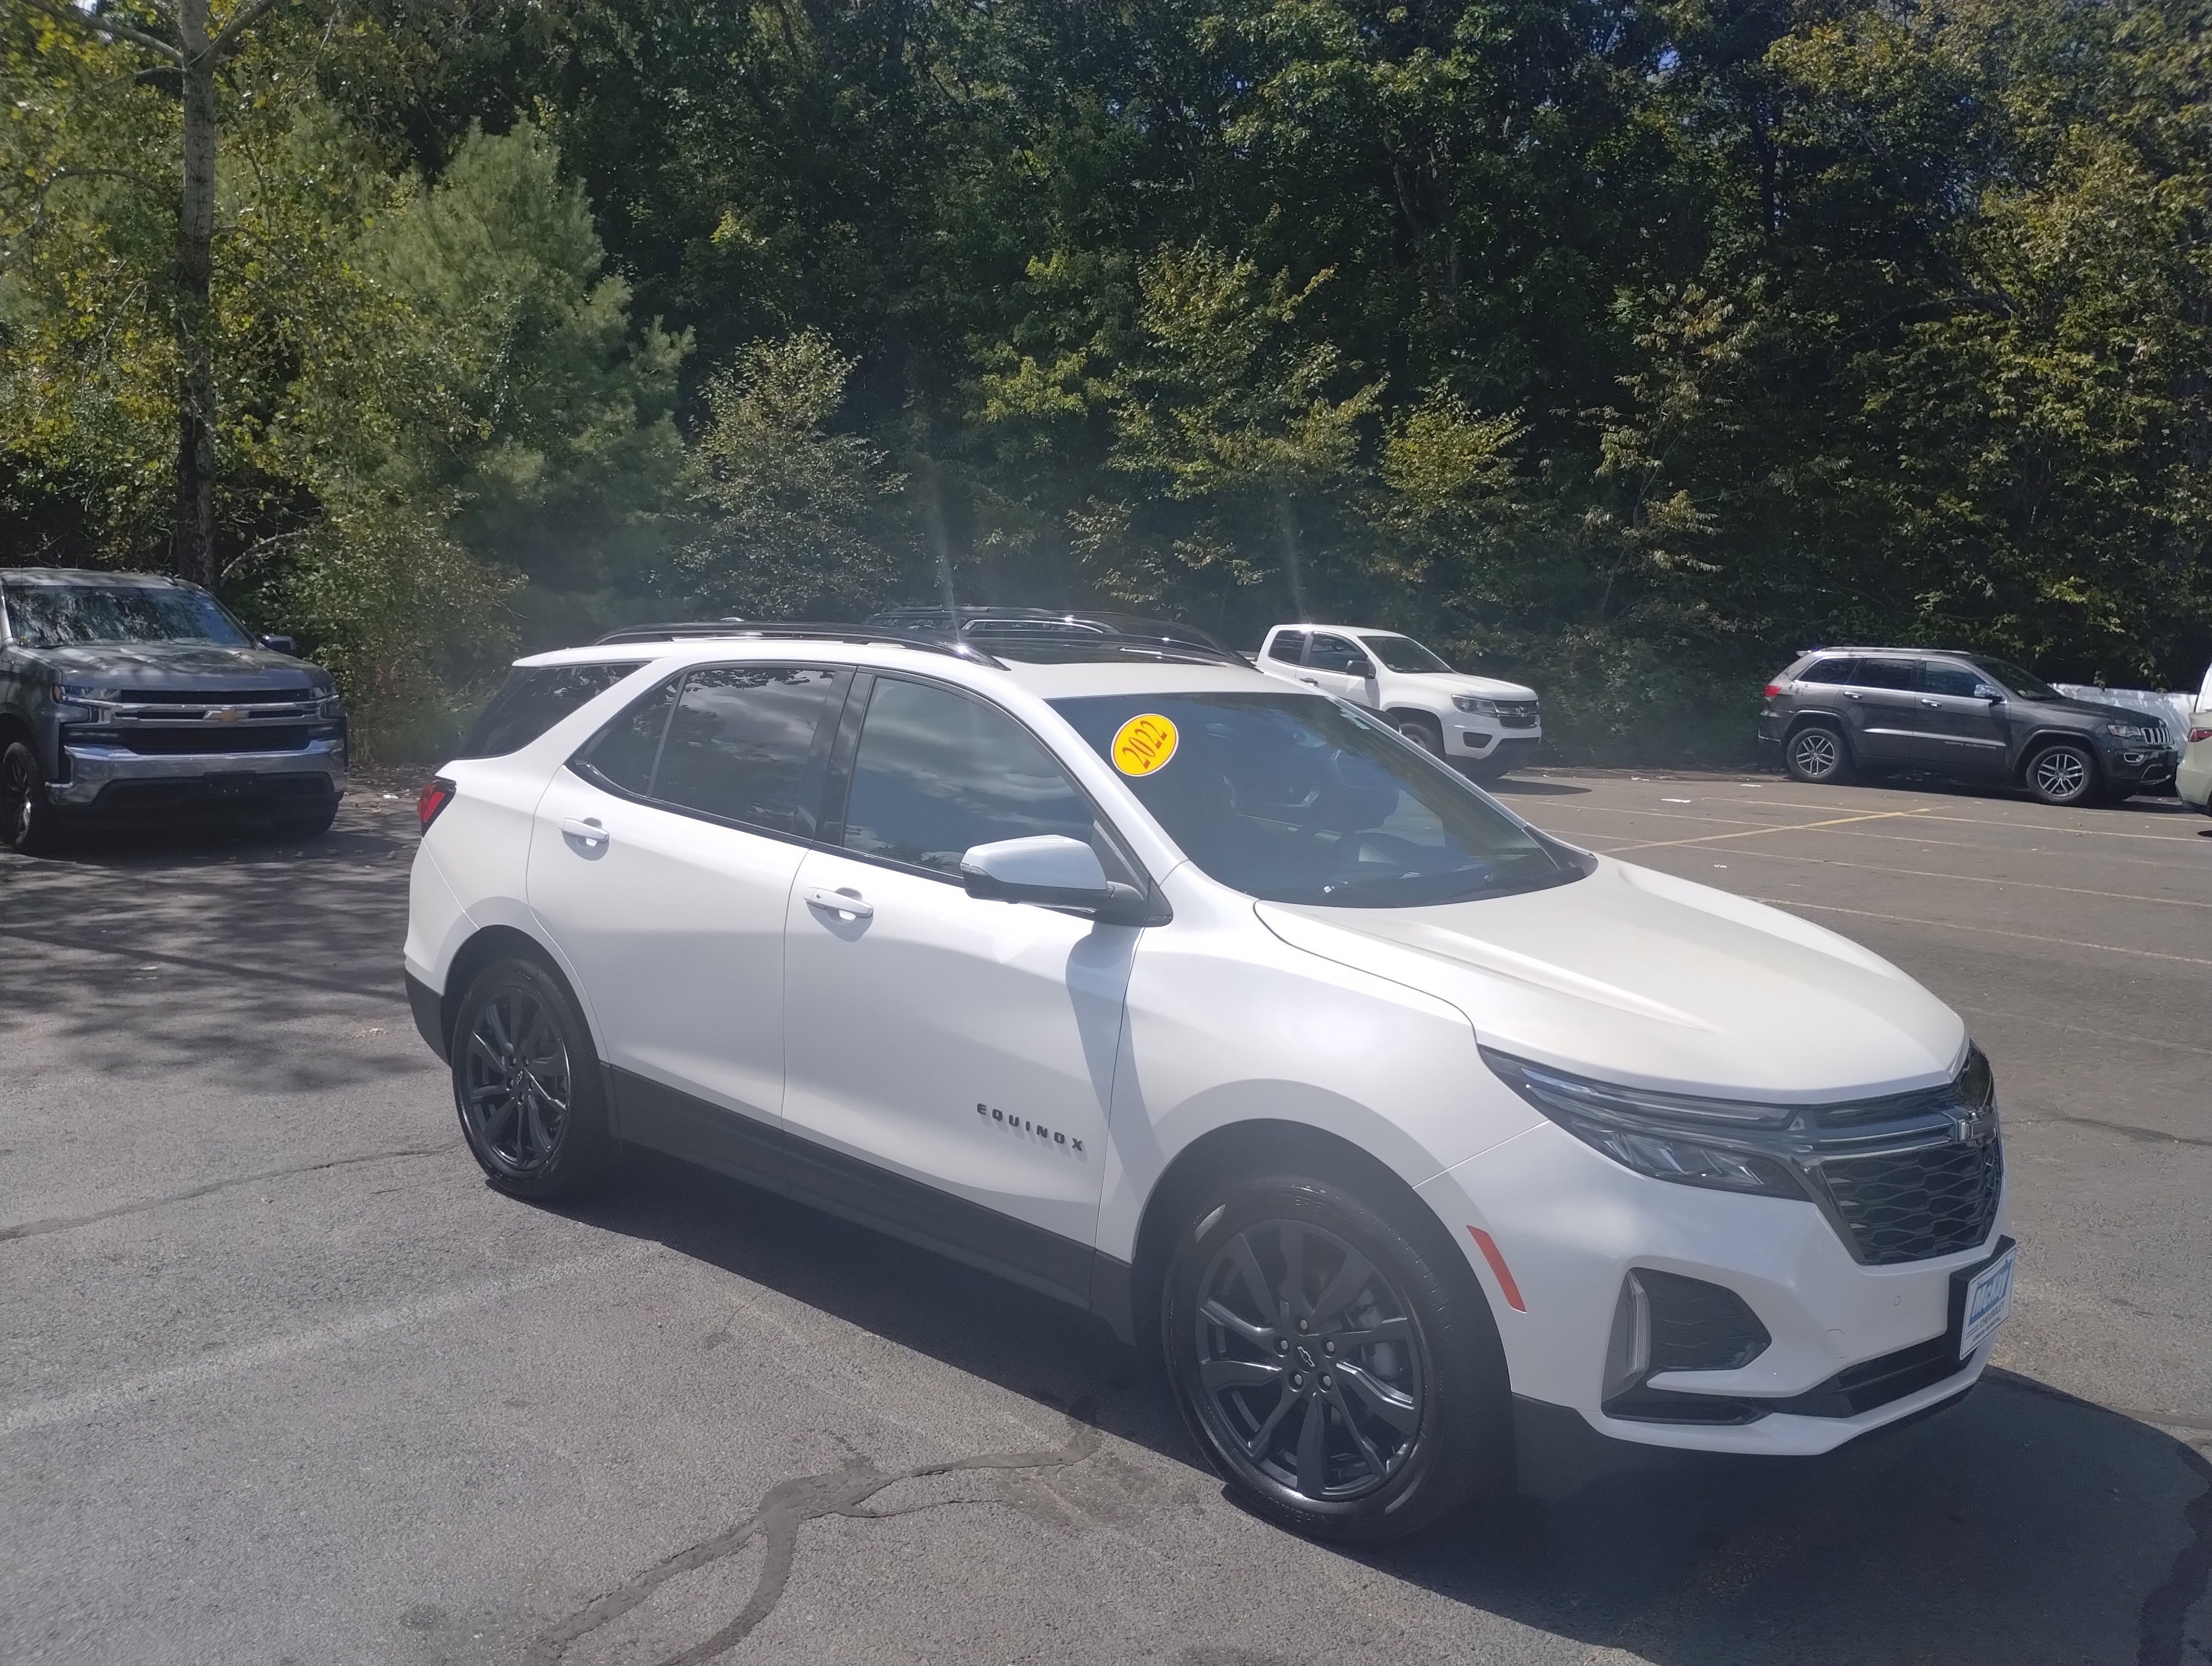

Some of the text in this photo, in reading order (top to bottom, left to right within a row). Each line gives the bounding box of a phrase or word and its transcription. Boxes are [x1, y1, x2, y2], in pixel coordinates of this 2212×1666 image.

[1122, 720, 1168, 770] 2022
[977, 1103, 1083, 1151] EQUINOX
[1971, 1268, 2009, 1317] McKay
